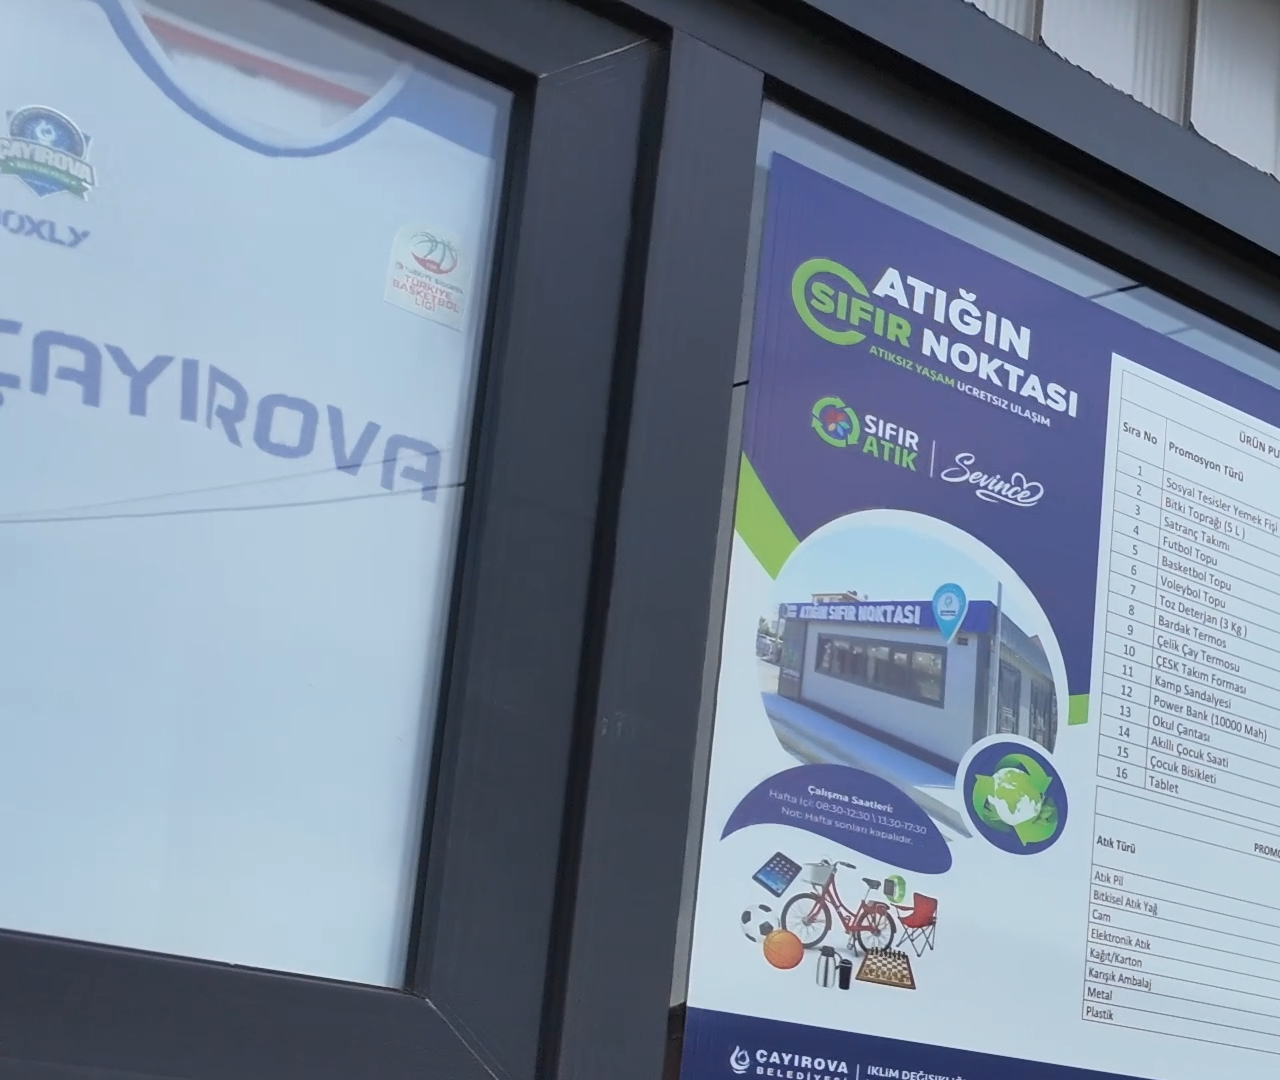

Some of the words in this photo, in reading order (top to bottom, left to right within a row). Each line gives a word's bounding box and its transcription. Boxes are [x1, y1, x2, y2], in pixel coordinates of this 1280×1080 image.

[0, 208, 91, 248] OXLY
[872, 267, 1031, 361] ATIĞIN
[810, 281, 912, 348] SIFIR
[921, 327, 1079, 418] NOKTASI
[868, 345, 914, 371] ATIKSIZ
[915, 364, 955, 388] YAŞAM
[864, 414, 919, 451] SIFIR
[1122, 421, 1141, 438] Sıra
[1143, 430, 1158, 445] No
[1239, 430, 1266, 453] ÜRÜN
[862, 435, 918, 472] ATIK
[1168, 441, 1221, 472] Promosyon
[1224, 465, 1244, 482] Türü
[940, 452, 1045, 507] Sevince
[1137, 465, 1143, 477] 1
[1136, 485, 1142, 497] 2
[1134, 504, 1141, 516] 3
[1165, 497, 1186, 513] Bitki
[1188, 507, 1222, 530] Toprağı
[1166, 477, 1195, 498] Sosyal
[1197, 490, 1231, 512] Tesisler
[1233, 505, 1262, 525] Yemek
[1264, 518, 1278, 534] Fişi
[1132, 525, 1139, 536] 4
[1164, 516, 1198, 541] Satranç
[1201, 530, 1230, 551] Takımı
[1132, 544, 1138, 556] 5
[1162, 536, 1192, 557] Futbol
[1195, 547, 1218, 567] Topu
[1130, 565, 1137, 576] 6
[1162, 556, 1207, 581] Basketbol
[1209, 573, 1232, 592] Topu
[1130, 584, 1136, 595] 7
[1160, 575, 1200, 599] Voleybol
[1203, 591, 1226, 610] Topu
[1128, 604, 1135, 616] 8
[1159, 595, 1176, 610] Toz
[1178, 602, 1218, 626] Deterjan
[1127, 624, 1134, 636] 9
[1158, 615, 1191, 636] Bardak
[1193, 627, 1227, 648] Termos
[1123, 644, 1136, 657] 10
[1157, 635, 1179, 652] Çelik
[1181, 643, 1199, 660] Çay
[1201, 650, 1240, 673] Termosu
[1122, 664, 1134, 677] 11
[1156, 655, 1179, 672] ÇESK
[1182, 663, 1209, 682] Takım
[1211, 673, 1247, 694] Forması
[1120, 684, 1133, 698] 12
[1155, 675, 1182, 694] Kamp
[1184, 684, 1232, 710] Sandalyesi
[1119, 705, 1131, 718] 13
[1153, 695, 1184, 713] Power
[1186, 705, 1209, 722] Bank
[1211, 713, 1242, 733] (10000
[1244, 724, 1268, 742] Mah)
[1118, 725, 1130, 738] 14
[1152, 715, 1175, 728] Okul
[1176, 723, 1210, 742] Çantası
[1117, 746, 1129, 759] 15
[1151, 735, 1174, 752] Akıllı
[1176, 743, 1205, 761] Çocuk
[1206, 752, 1229, 768] Saati
[1116, 766, 1128, 779] 16
[1150, 755, 1179, 773] Çocuk
[1181, 764, 1217, 784] Bisikleti
[1149, 775, 1179, 794] Tablet
[769, 789, 797, 804] Hafta
[805, 811, 832, 826] Hafta
[1096, 835, 1114, 849] Atık
[1092, 909, 1111, 922] Cam
[1091, 928, 1132, 946] Elektronik
[1087, 987, 1112, 1000] Metal
[1118, 973, 1152, 991] Ambalaj
[1086, 1006, 1113, 1020] Plastik
[756, 1049, 849, 1074] ÇAYIROVA
